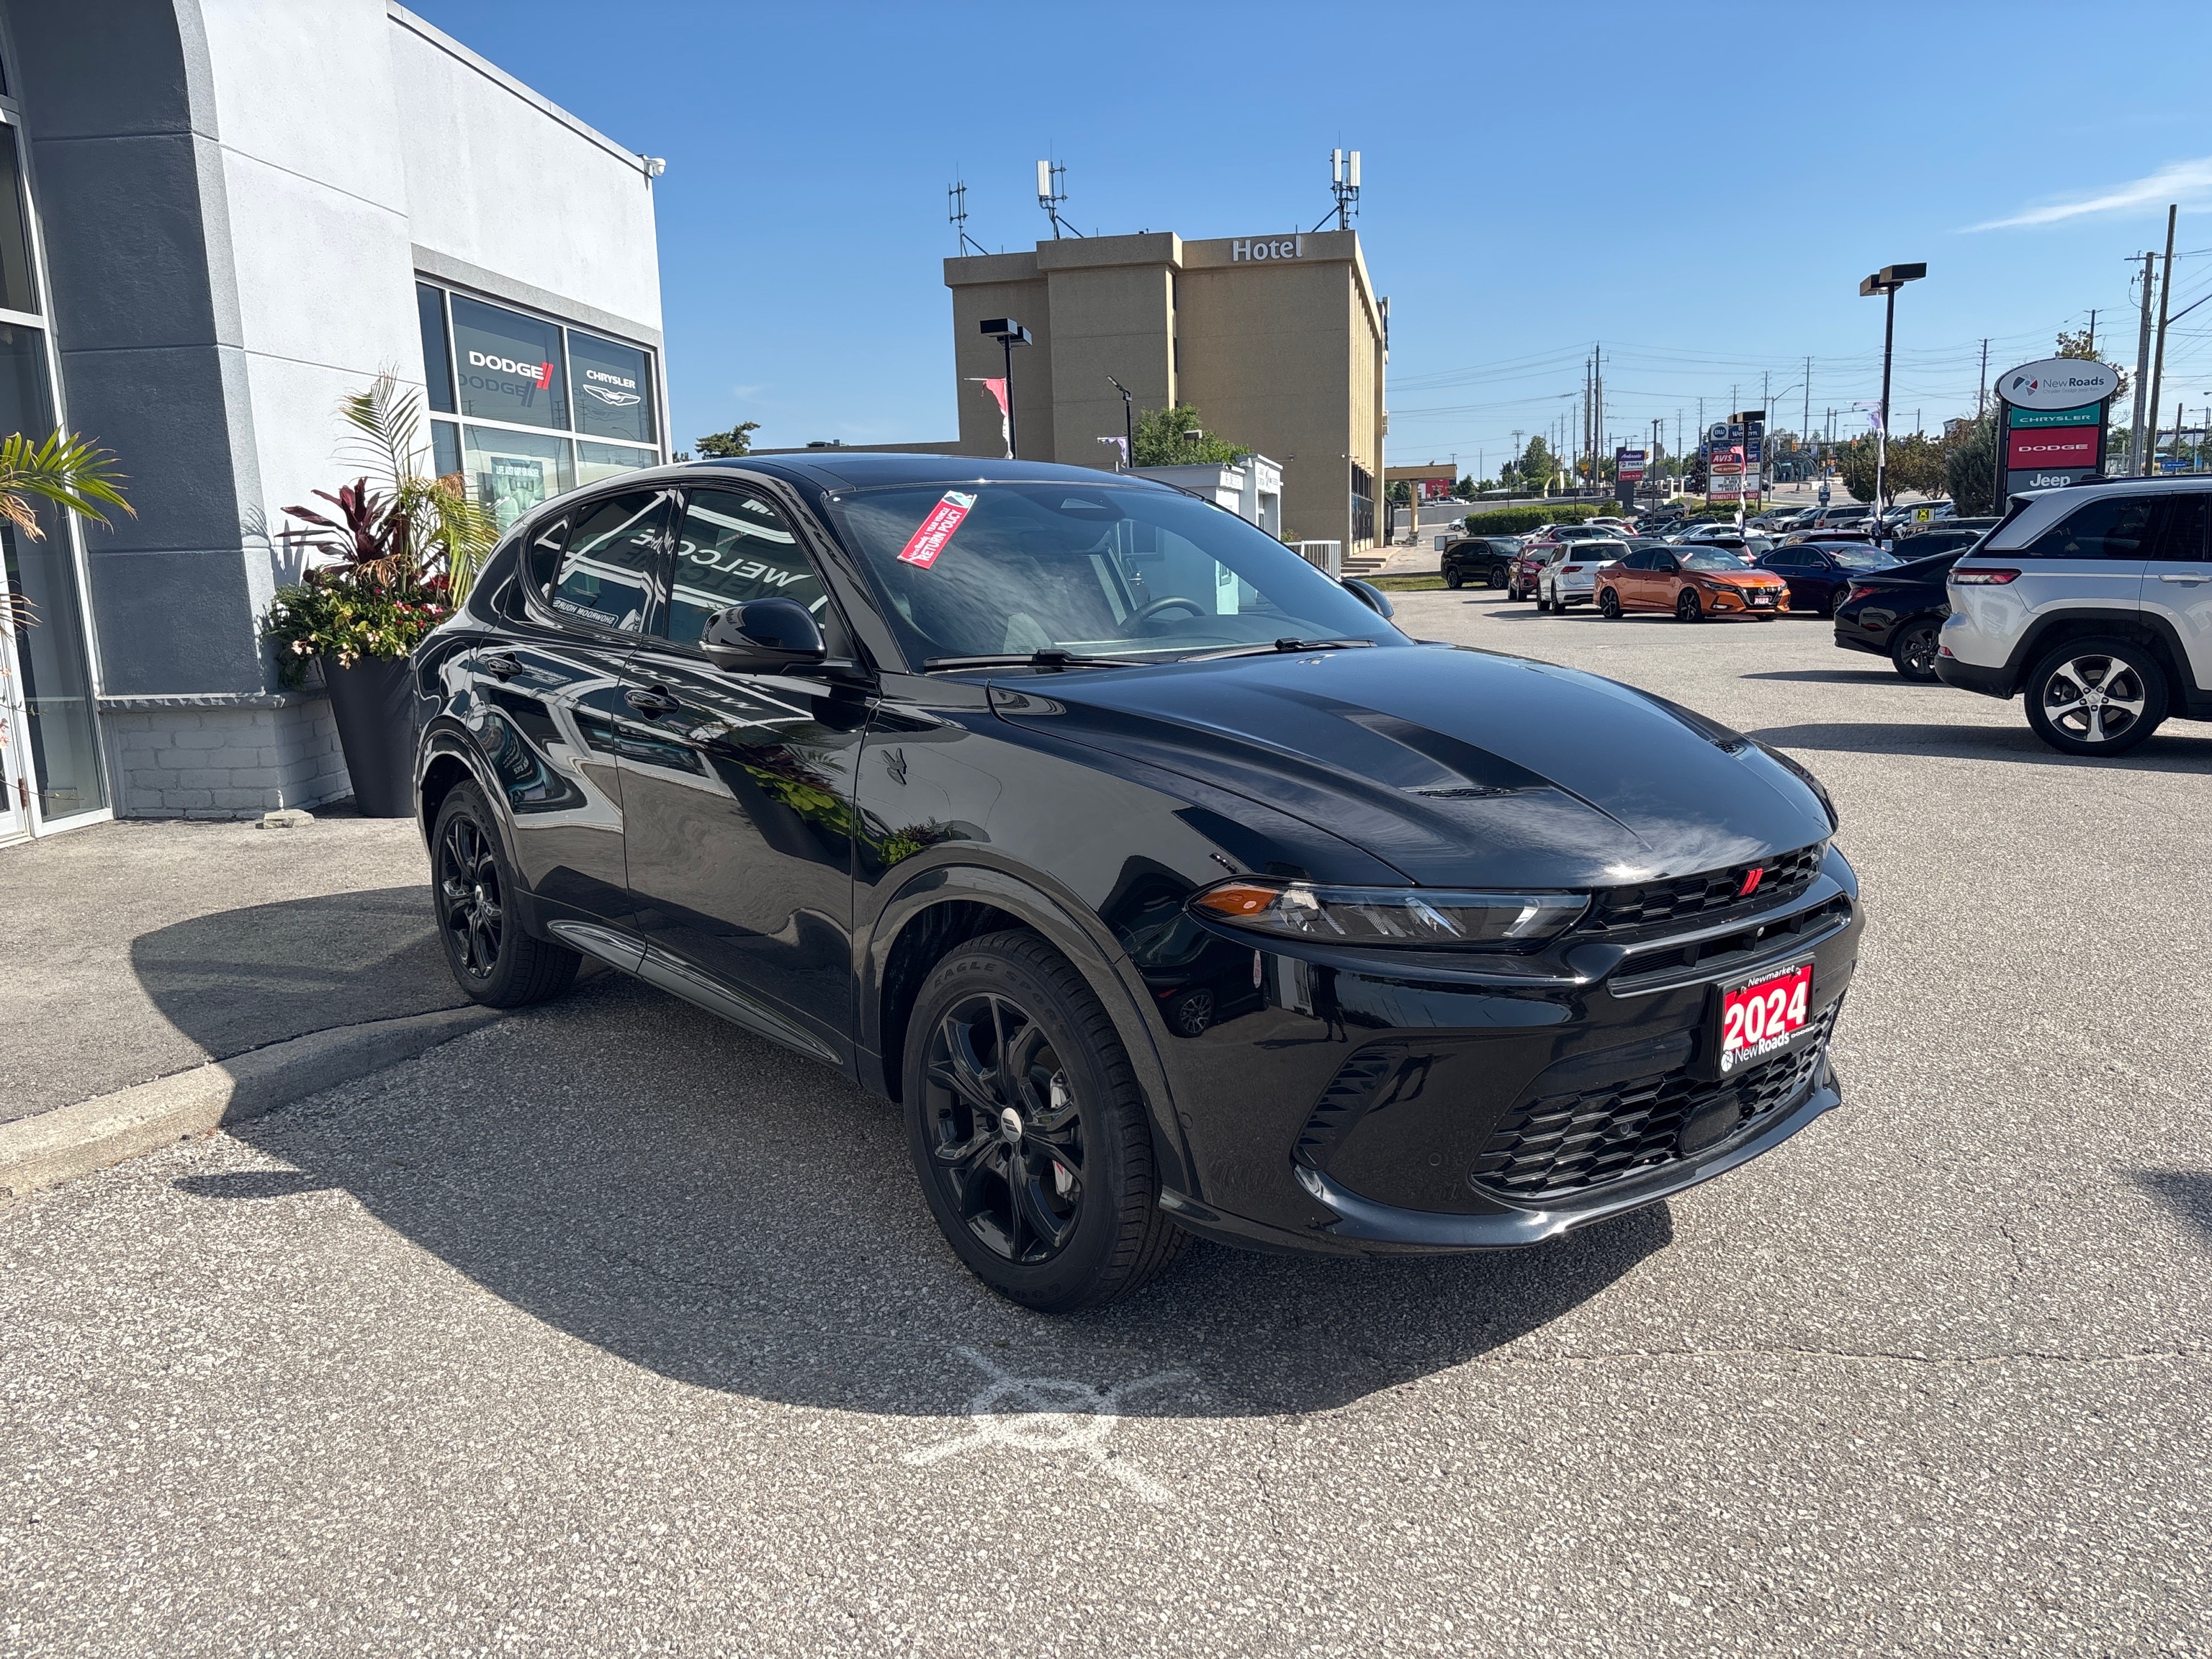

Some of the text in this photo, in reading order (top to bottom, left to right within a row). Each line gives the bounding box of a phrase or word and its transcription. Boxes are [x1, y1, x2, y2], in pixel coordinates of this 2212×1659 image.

[1233, 235, 1303, 261] Hotel
[469, 350, 544, 380] DODGE
[586, 369, 636, 390] CHRYSLER
[2018, 444, 2088, 452] DODGE
[2030, 473, 2071, 487] Jeep
[920, 509, 963, 562] RETURN POLICY
[926, 519, 939, 534] YEAR
[1748, 964, 1795, 987] Newmarket
[933, 961, 1071, 1041] EAGLE SPORT
[1723, 981, 1807, 1051] 2024
[1791, 1025, 1815, 1038] DODGE
